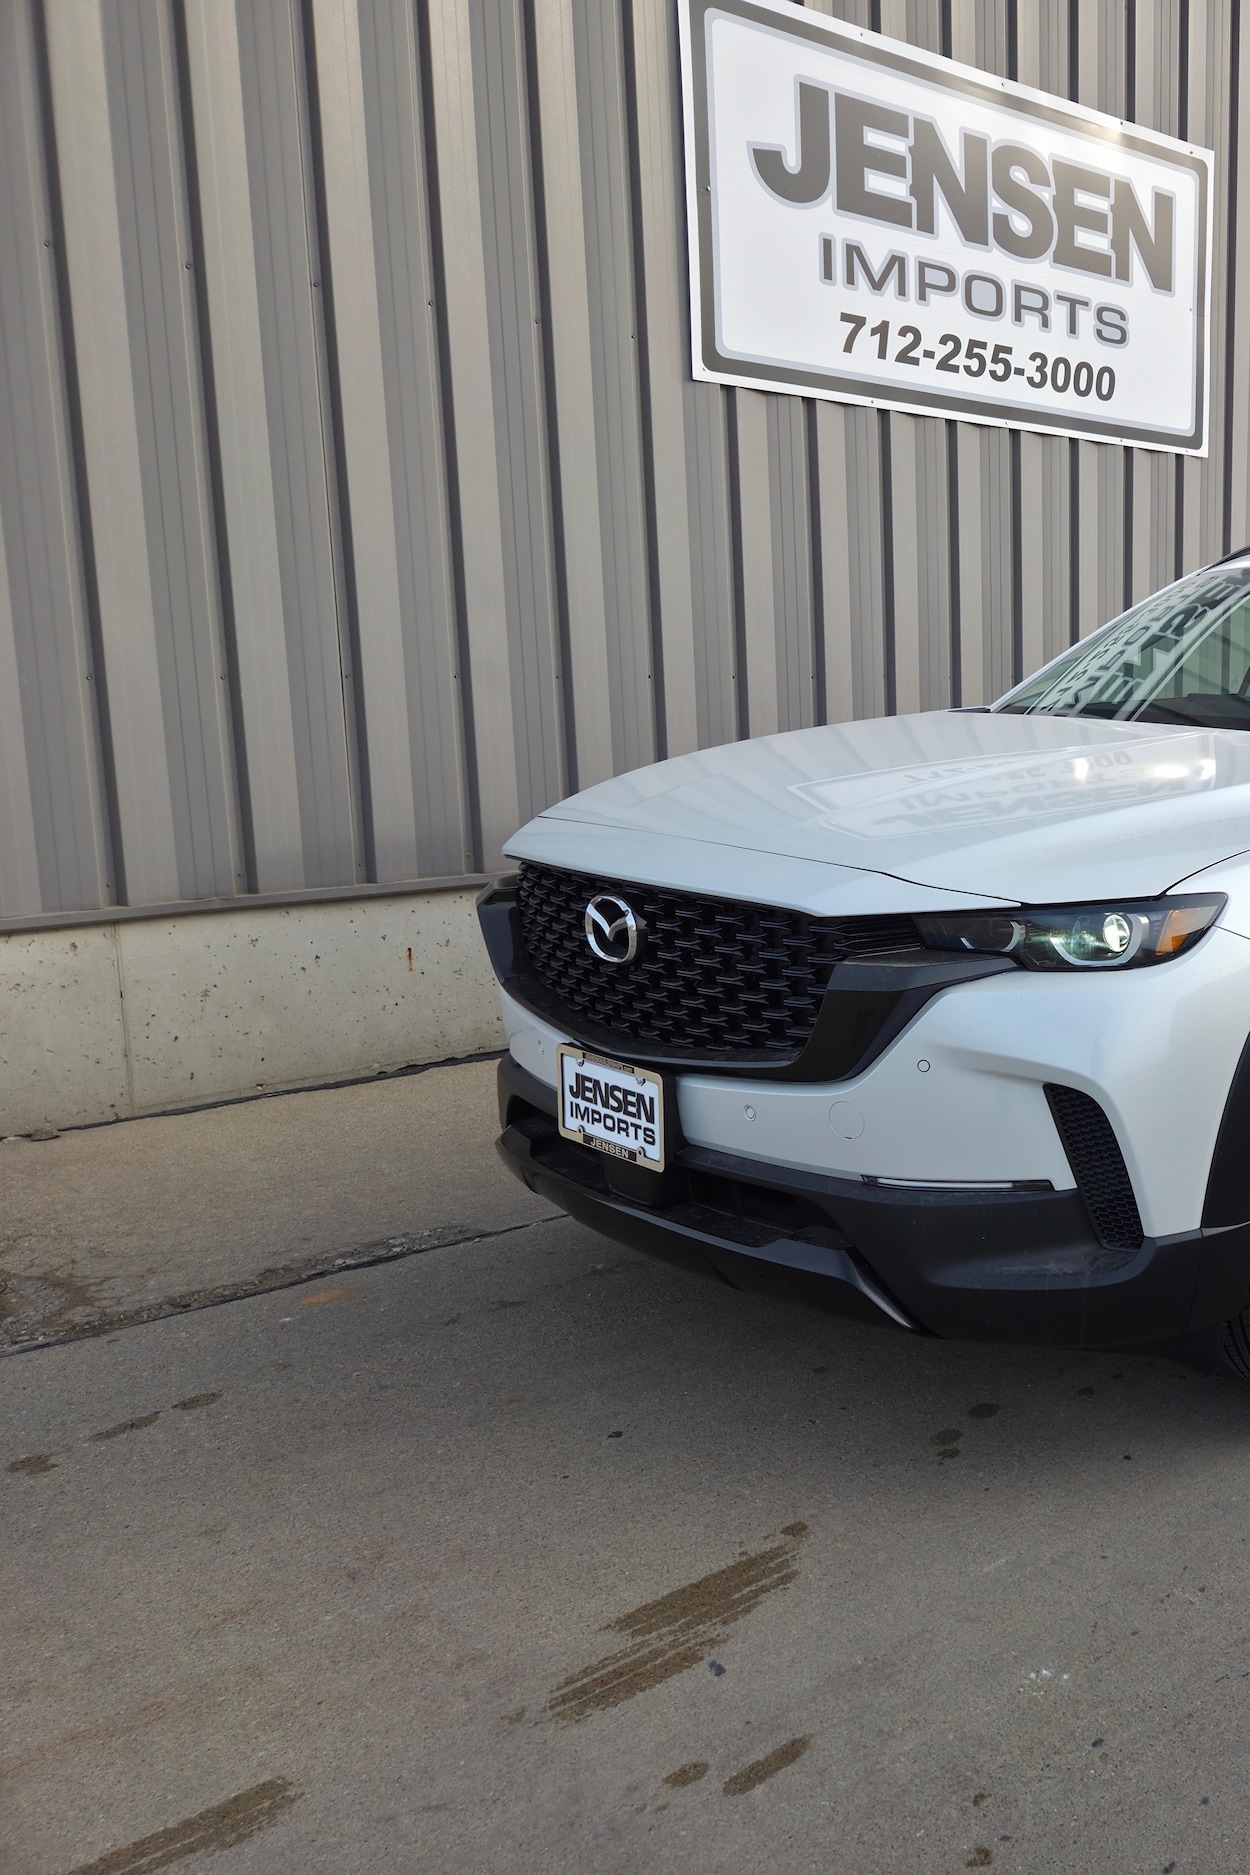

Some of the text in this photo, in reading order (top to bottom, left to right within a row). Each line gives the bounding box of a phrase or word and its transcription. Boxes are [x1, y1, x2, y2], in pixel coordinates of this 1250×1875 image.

[751, 79, 1175, 294] JENSEN
[821, 237, 1129, 346] IMPORTS
[839, 312, 1116, 402] 712-255-3000
[569, 1072, 655, 1125] JENSEN
[570, 1101, 656, 1146] IMPORTS
[590, 1138, 629, 1159] JENSEN
